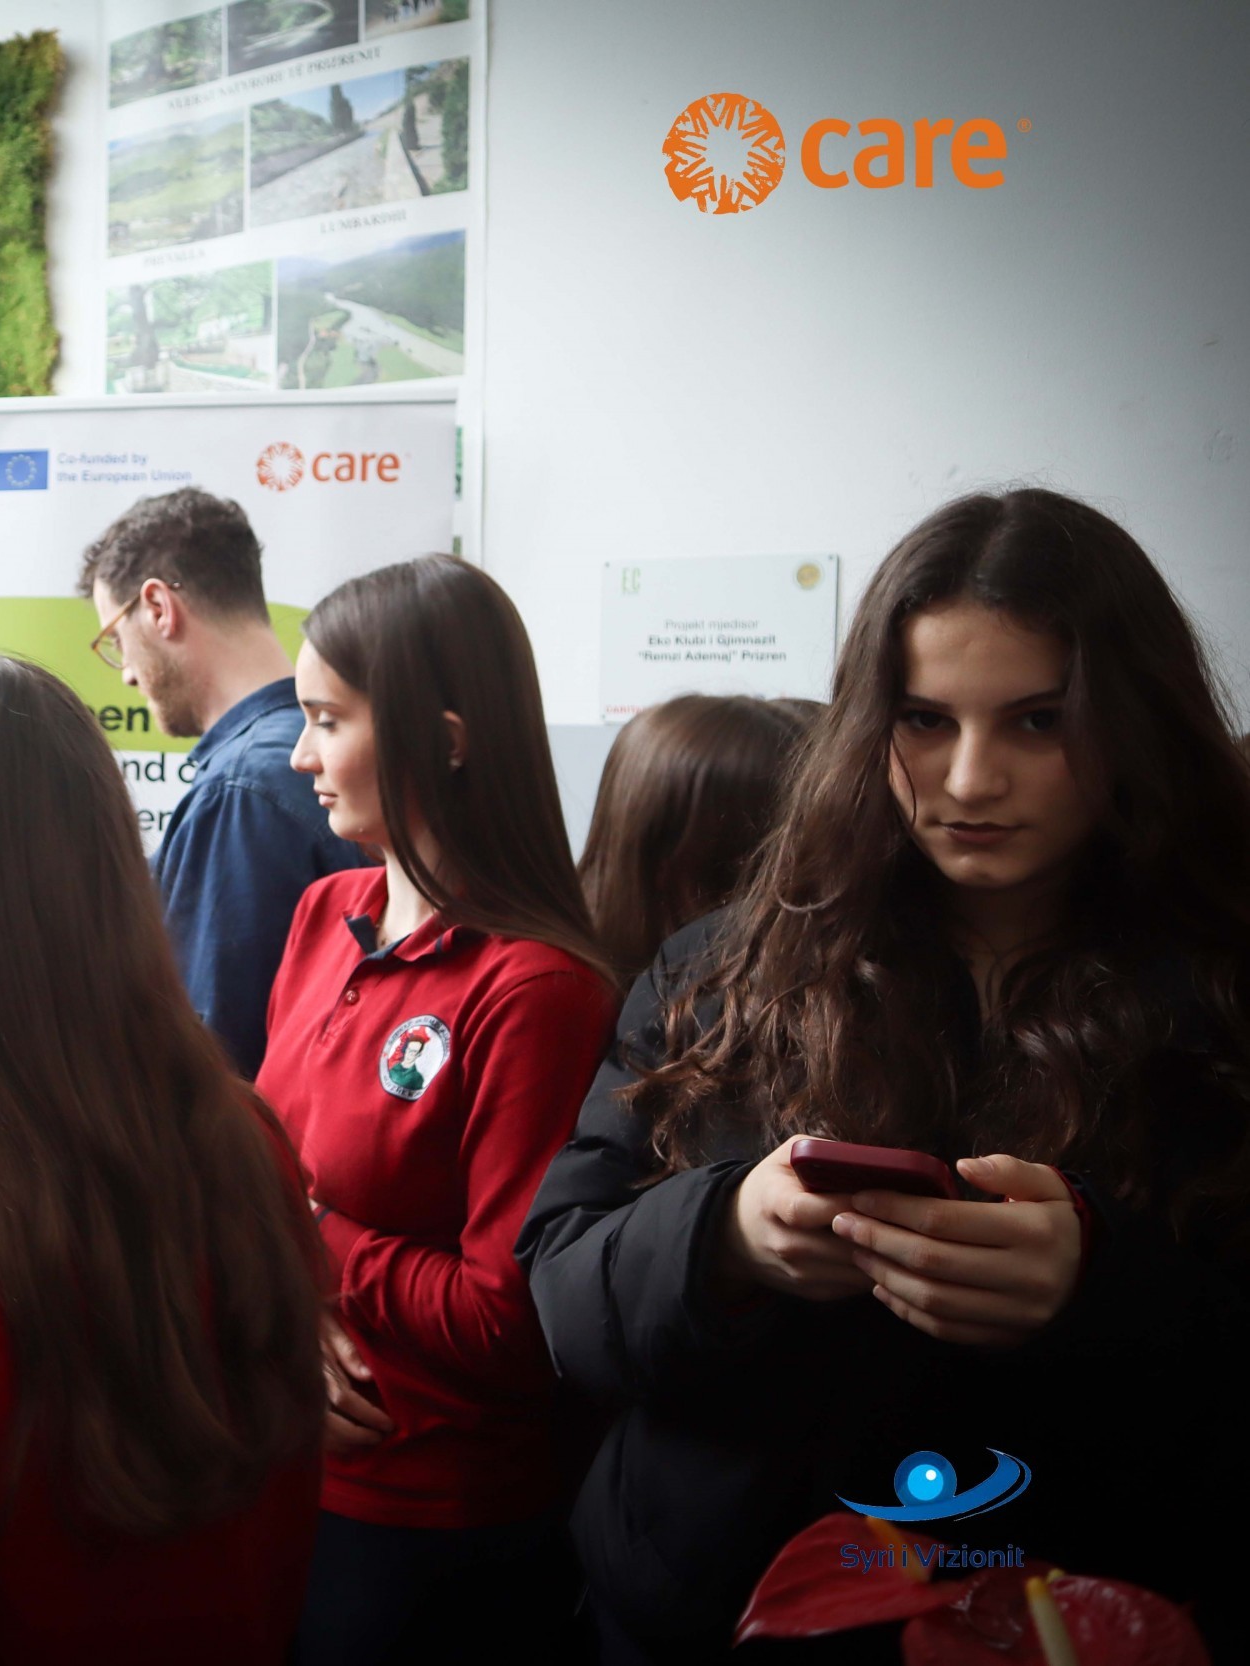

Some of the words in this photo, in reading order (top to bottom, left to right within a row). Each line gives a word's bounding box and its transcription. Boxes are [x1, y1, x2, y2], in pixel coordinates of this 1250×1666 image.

[57, 453, 129, 465] Co-funded
[132, 453, 148, 467] by
[311, 453, 401, 483] care
[56, 470, 78, 482] the
[81, 470, 148, 484] European
[151, 470, 192, 482] Union
[664, 618, 705, 631] Projekt
[708, 618, 760, 631] mjedisor
[648, 634, 671, 646] Eko
[675, 634, 707, 646] Klubi
[741, 650, 787, 662] Prizren
[97, 705, 150, 732] en
[123, 752, 166, 783] nd
